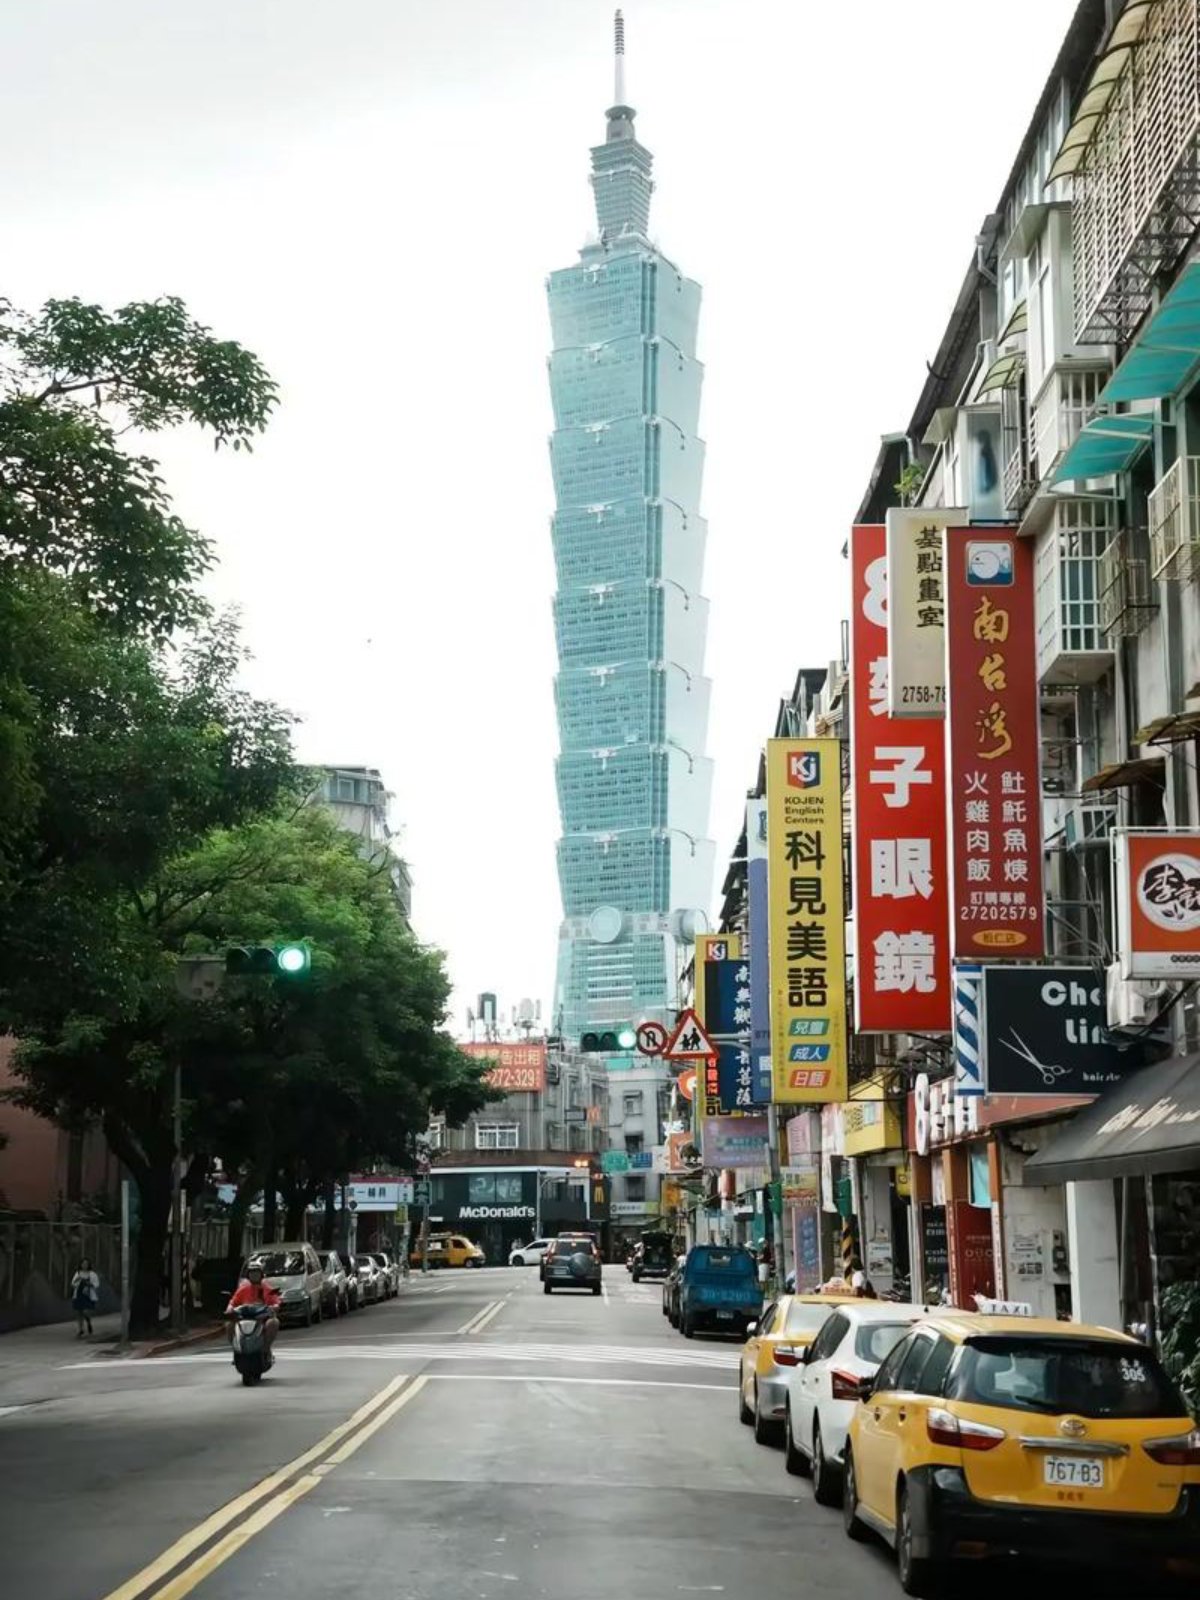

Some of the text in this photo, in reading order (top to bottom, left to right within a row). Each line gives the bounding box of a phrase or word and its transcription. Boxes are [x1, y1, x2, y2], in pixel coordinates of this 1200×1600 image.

[785, 796, 824, 804] KOJEN
[785, 807, 824, 815] English
[785, 816, 824, 824] Centers
[964, 770, 992, 882] 火雞肉飯
[785, 830, 828, 1007] 科見美語
[961, 905, 1038, 920] 27202579
[793, 1047, 823, 1060] 成人
[459, 1206, 536, 1219] McDonald's
[992, 1303, 1028, 1315] TAXI
